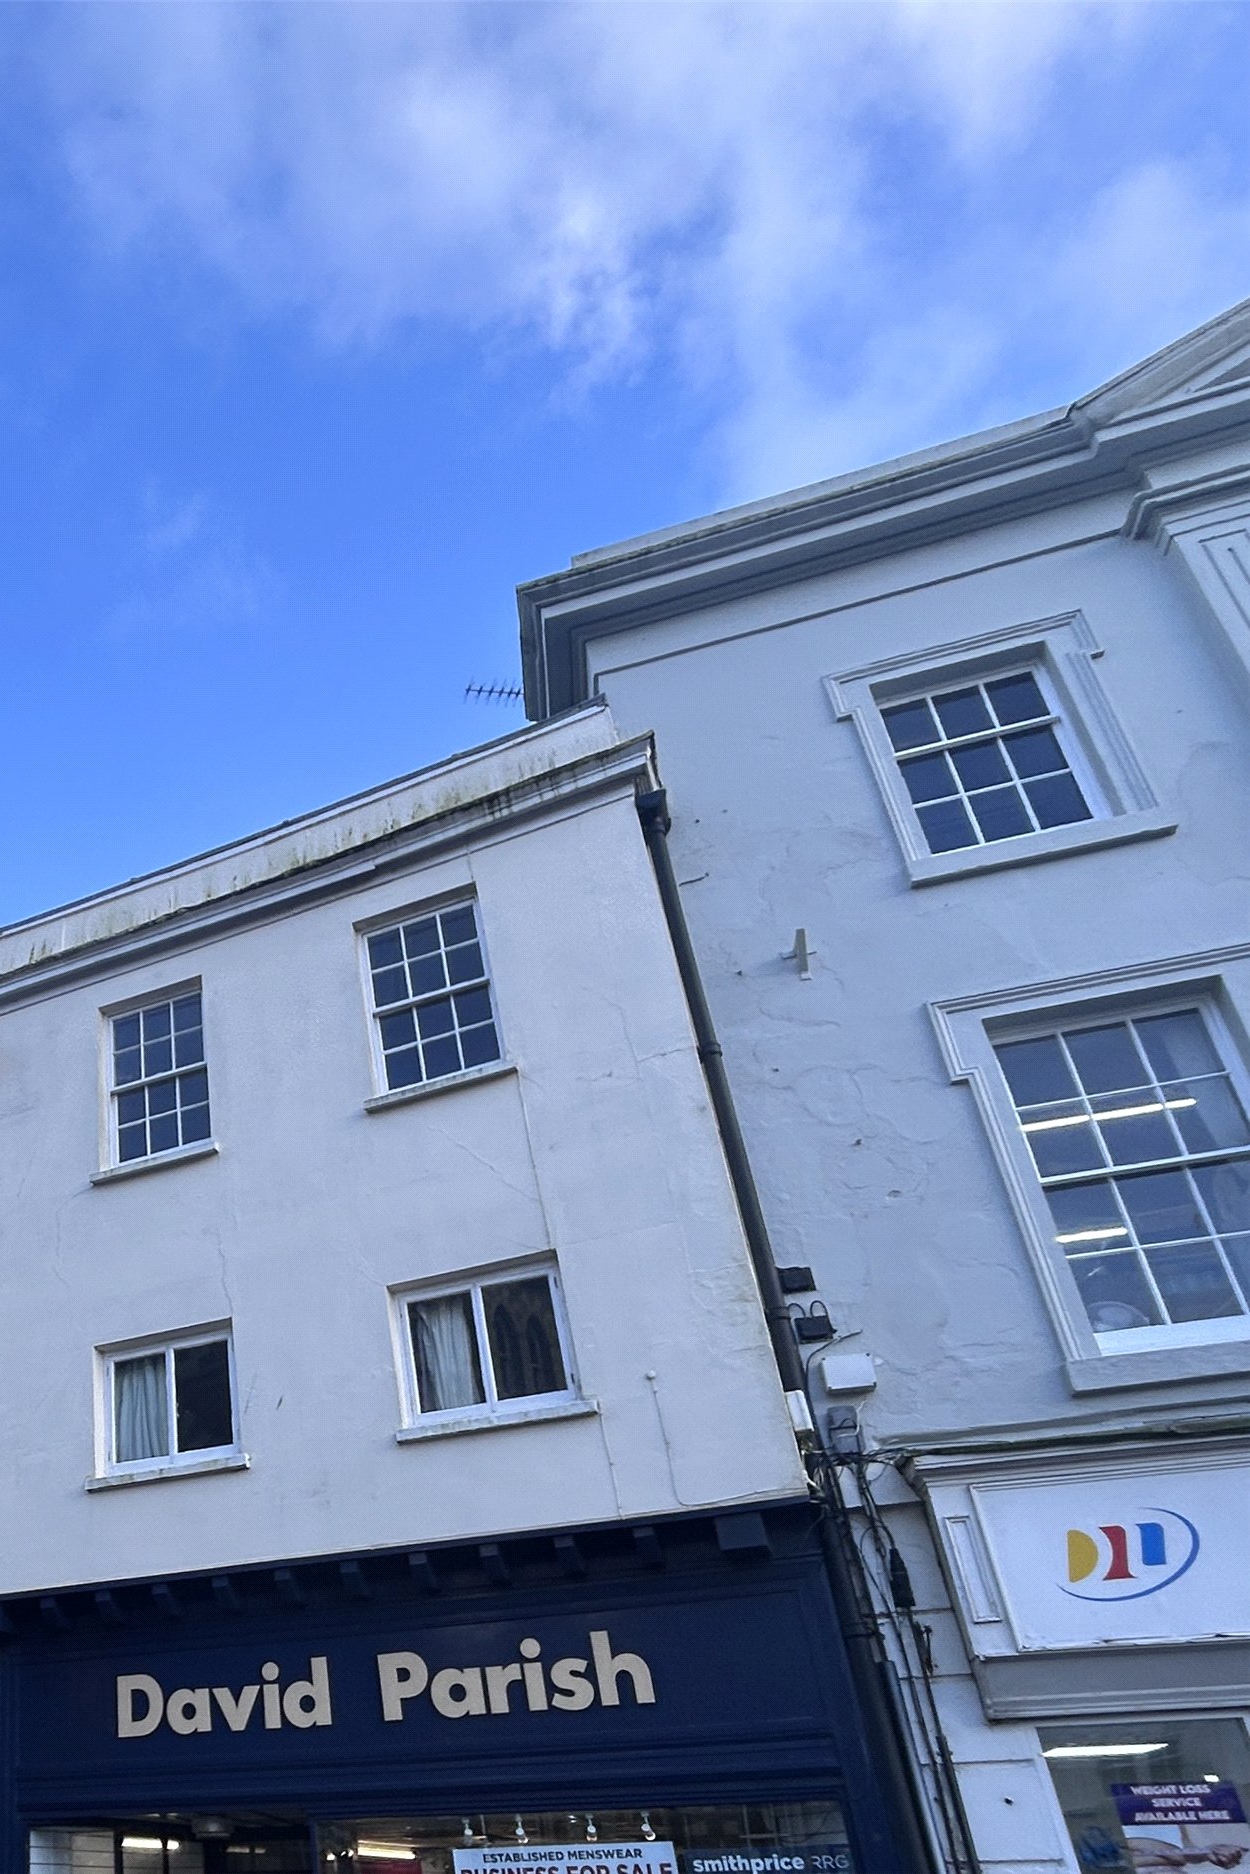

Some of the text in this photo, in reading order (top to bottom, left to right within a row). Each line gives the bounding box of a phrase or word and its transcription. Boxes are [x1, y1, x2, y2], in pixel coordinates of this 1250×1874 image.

[116, 1630, 656, 1738] David Parish
[1130, 1784, 1212, 1796] WEIGHT LOSS
[1151, 1797, 1203, 1808] SERVICE
[1134, 1810, 1231, 1822] AVAILABLE HERE
[482, 1848, 644, 1864] ESTABLISHED MENSWEAR
[692, 1852, 806, 1874] smithprice
